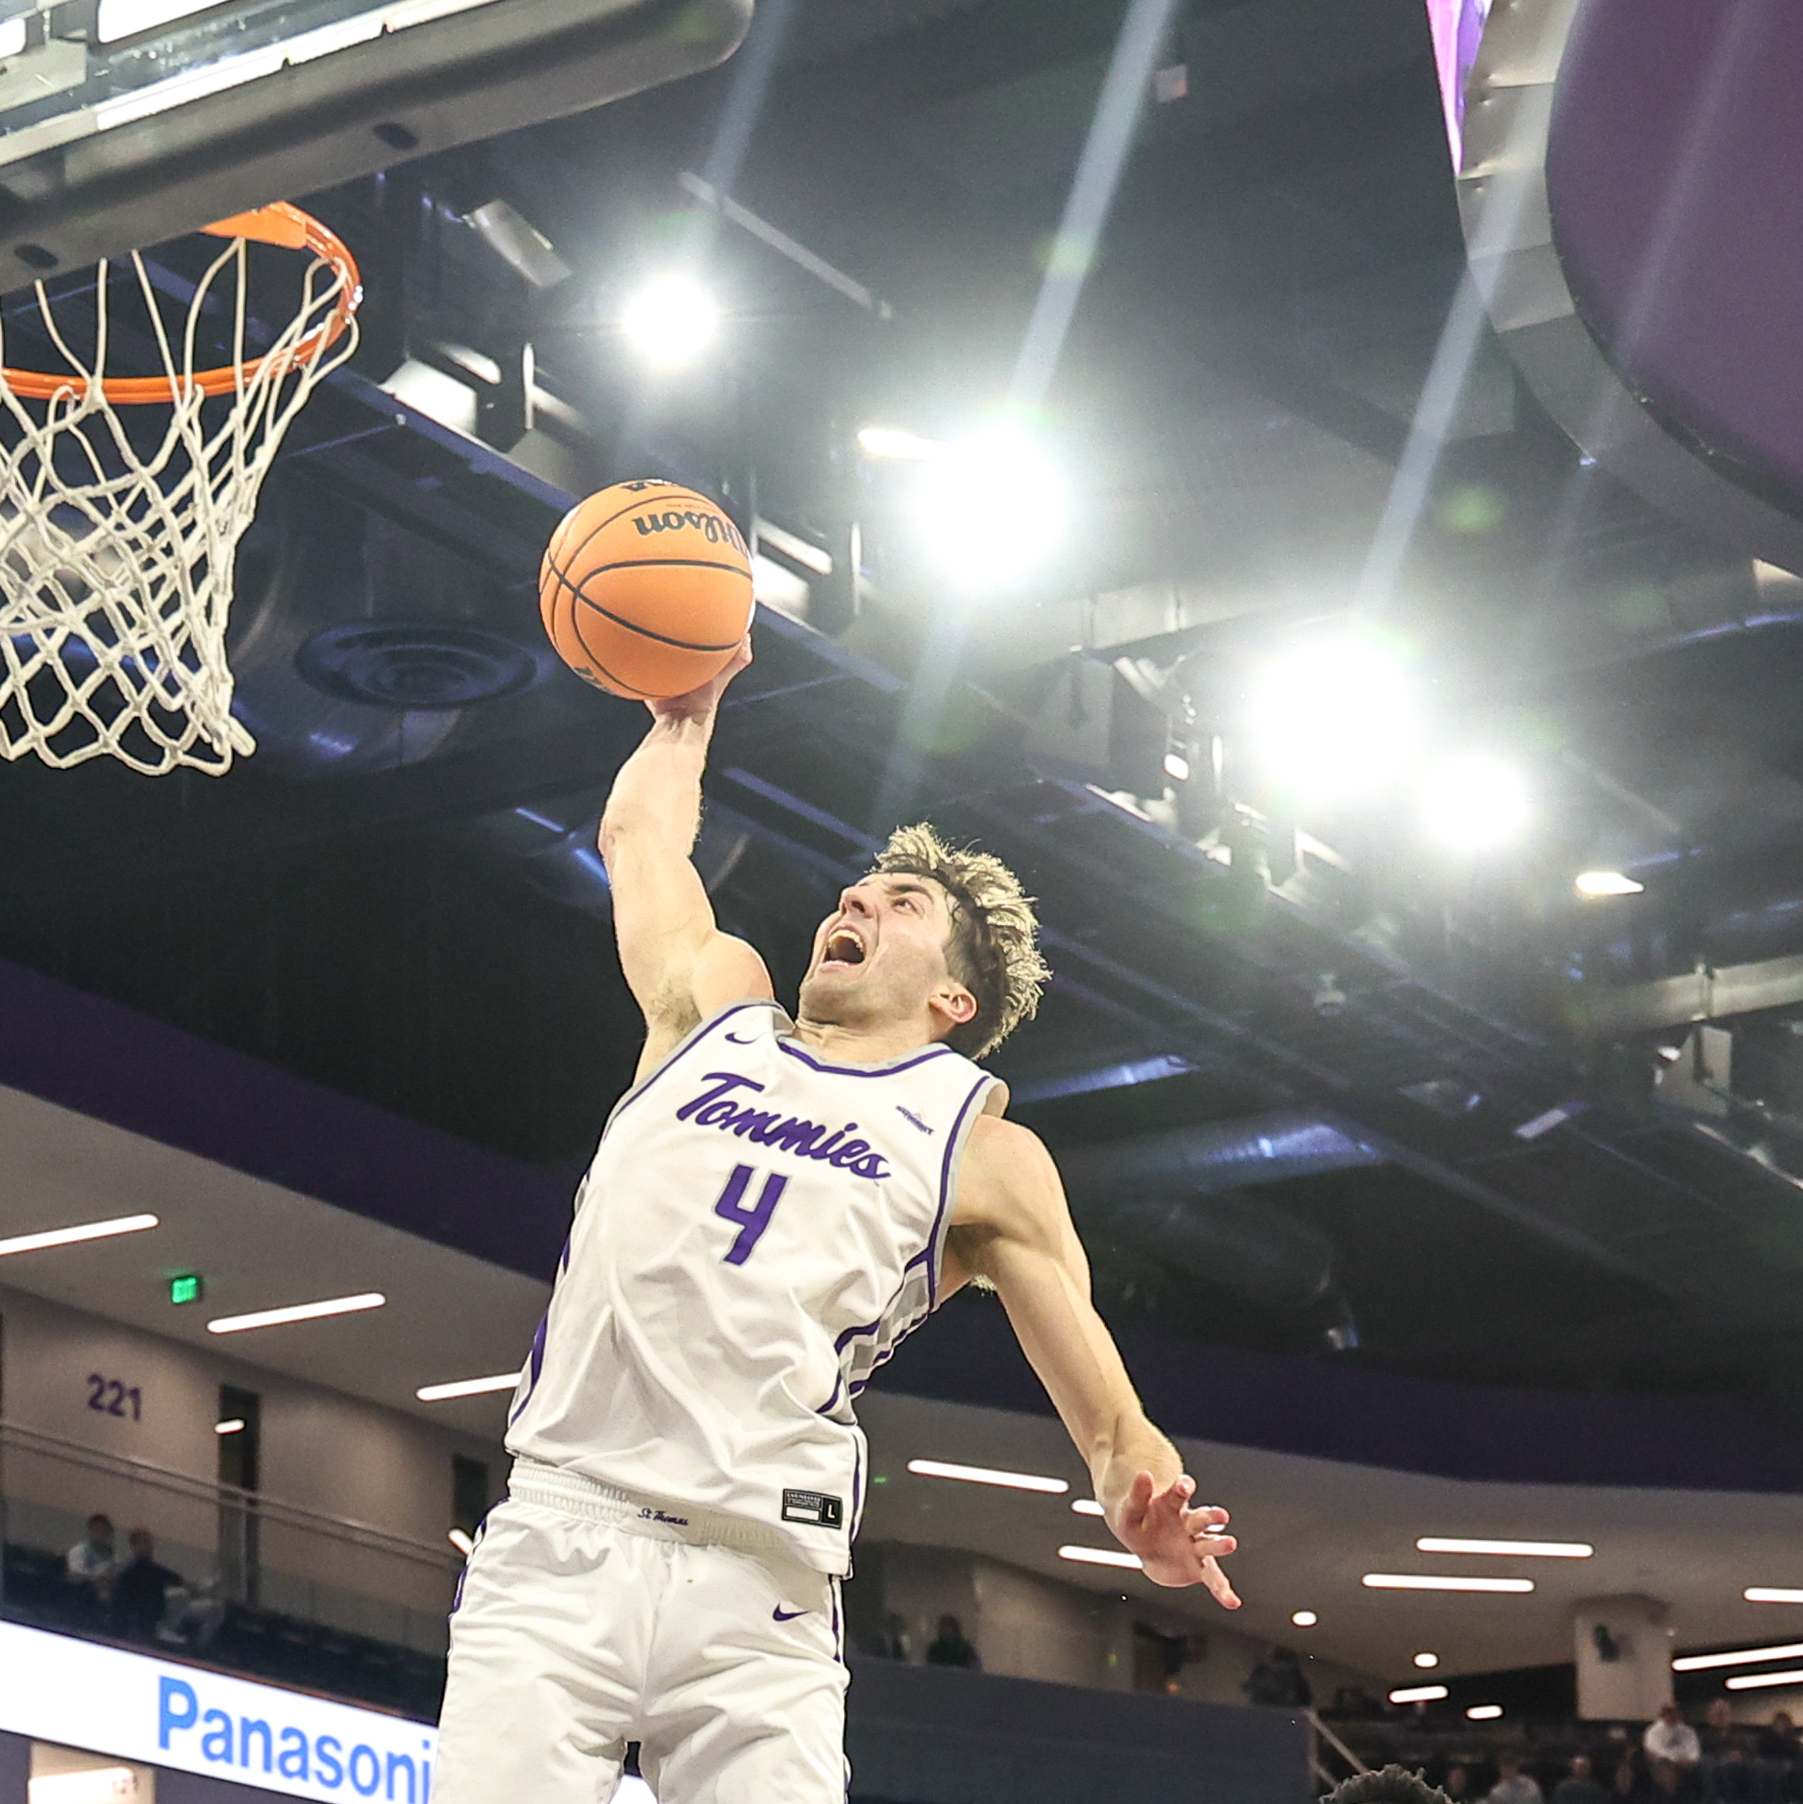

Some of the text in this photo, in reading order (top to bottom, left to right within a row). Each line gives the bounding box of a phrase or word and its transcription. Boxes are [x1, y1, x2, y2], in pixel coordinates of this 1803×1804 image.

[675, 1072, 892, 1181] Tommies
[713, 1163, 789, 1265] 4
[85, 1372, 144, 1422] 221
[827, 1503, 836, 1519] L
